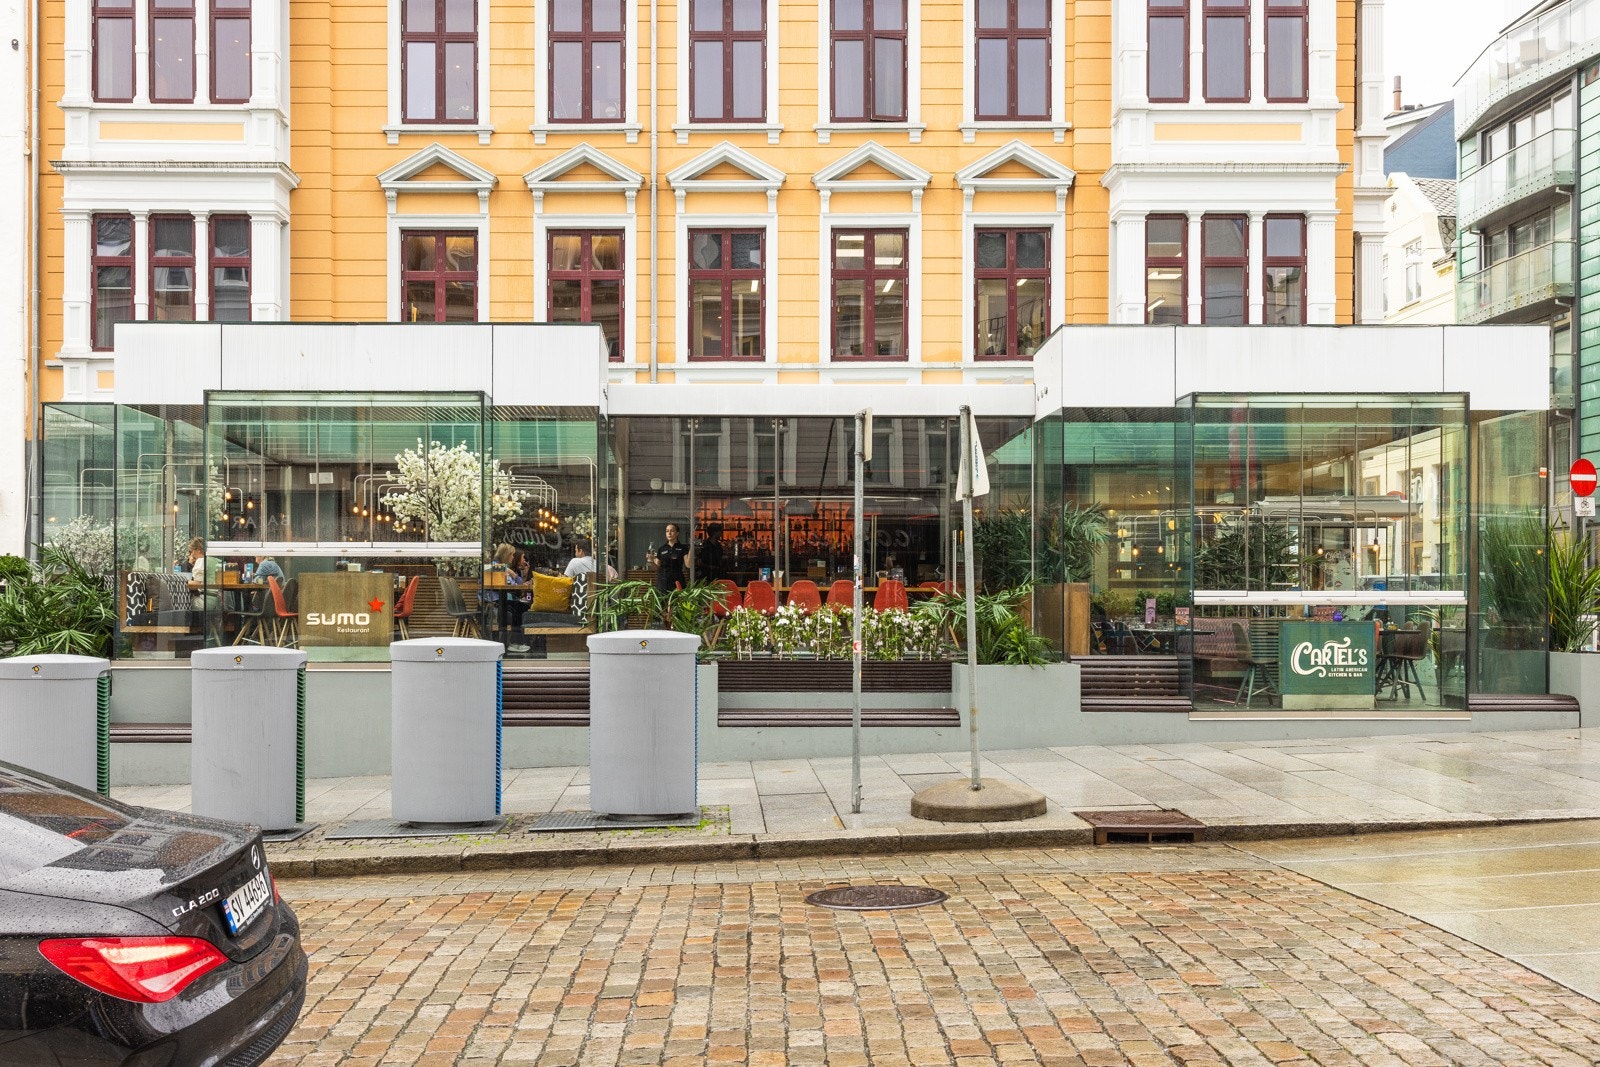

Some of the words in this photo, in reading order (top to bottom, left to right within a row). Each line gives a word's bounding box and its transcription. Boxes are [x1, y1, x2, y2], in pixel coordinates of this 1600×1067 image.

[306, 612, 370, 626] SUMO
[172, 899, 199, 918] CLA
[198, 888, 220, 905] 200
[231, 894, 245, 923] SV
